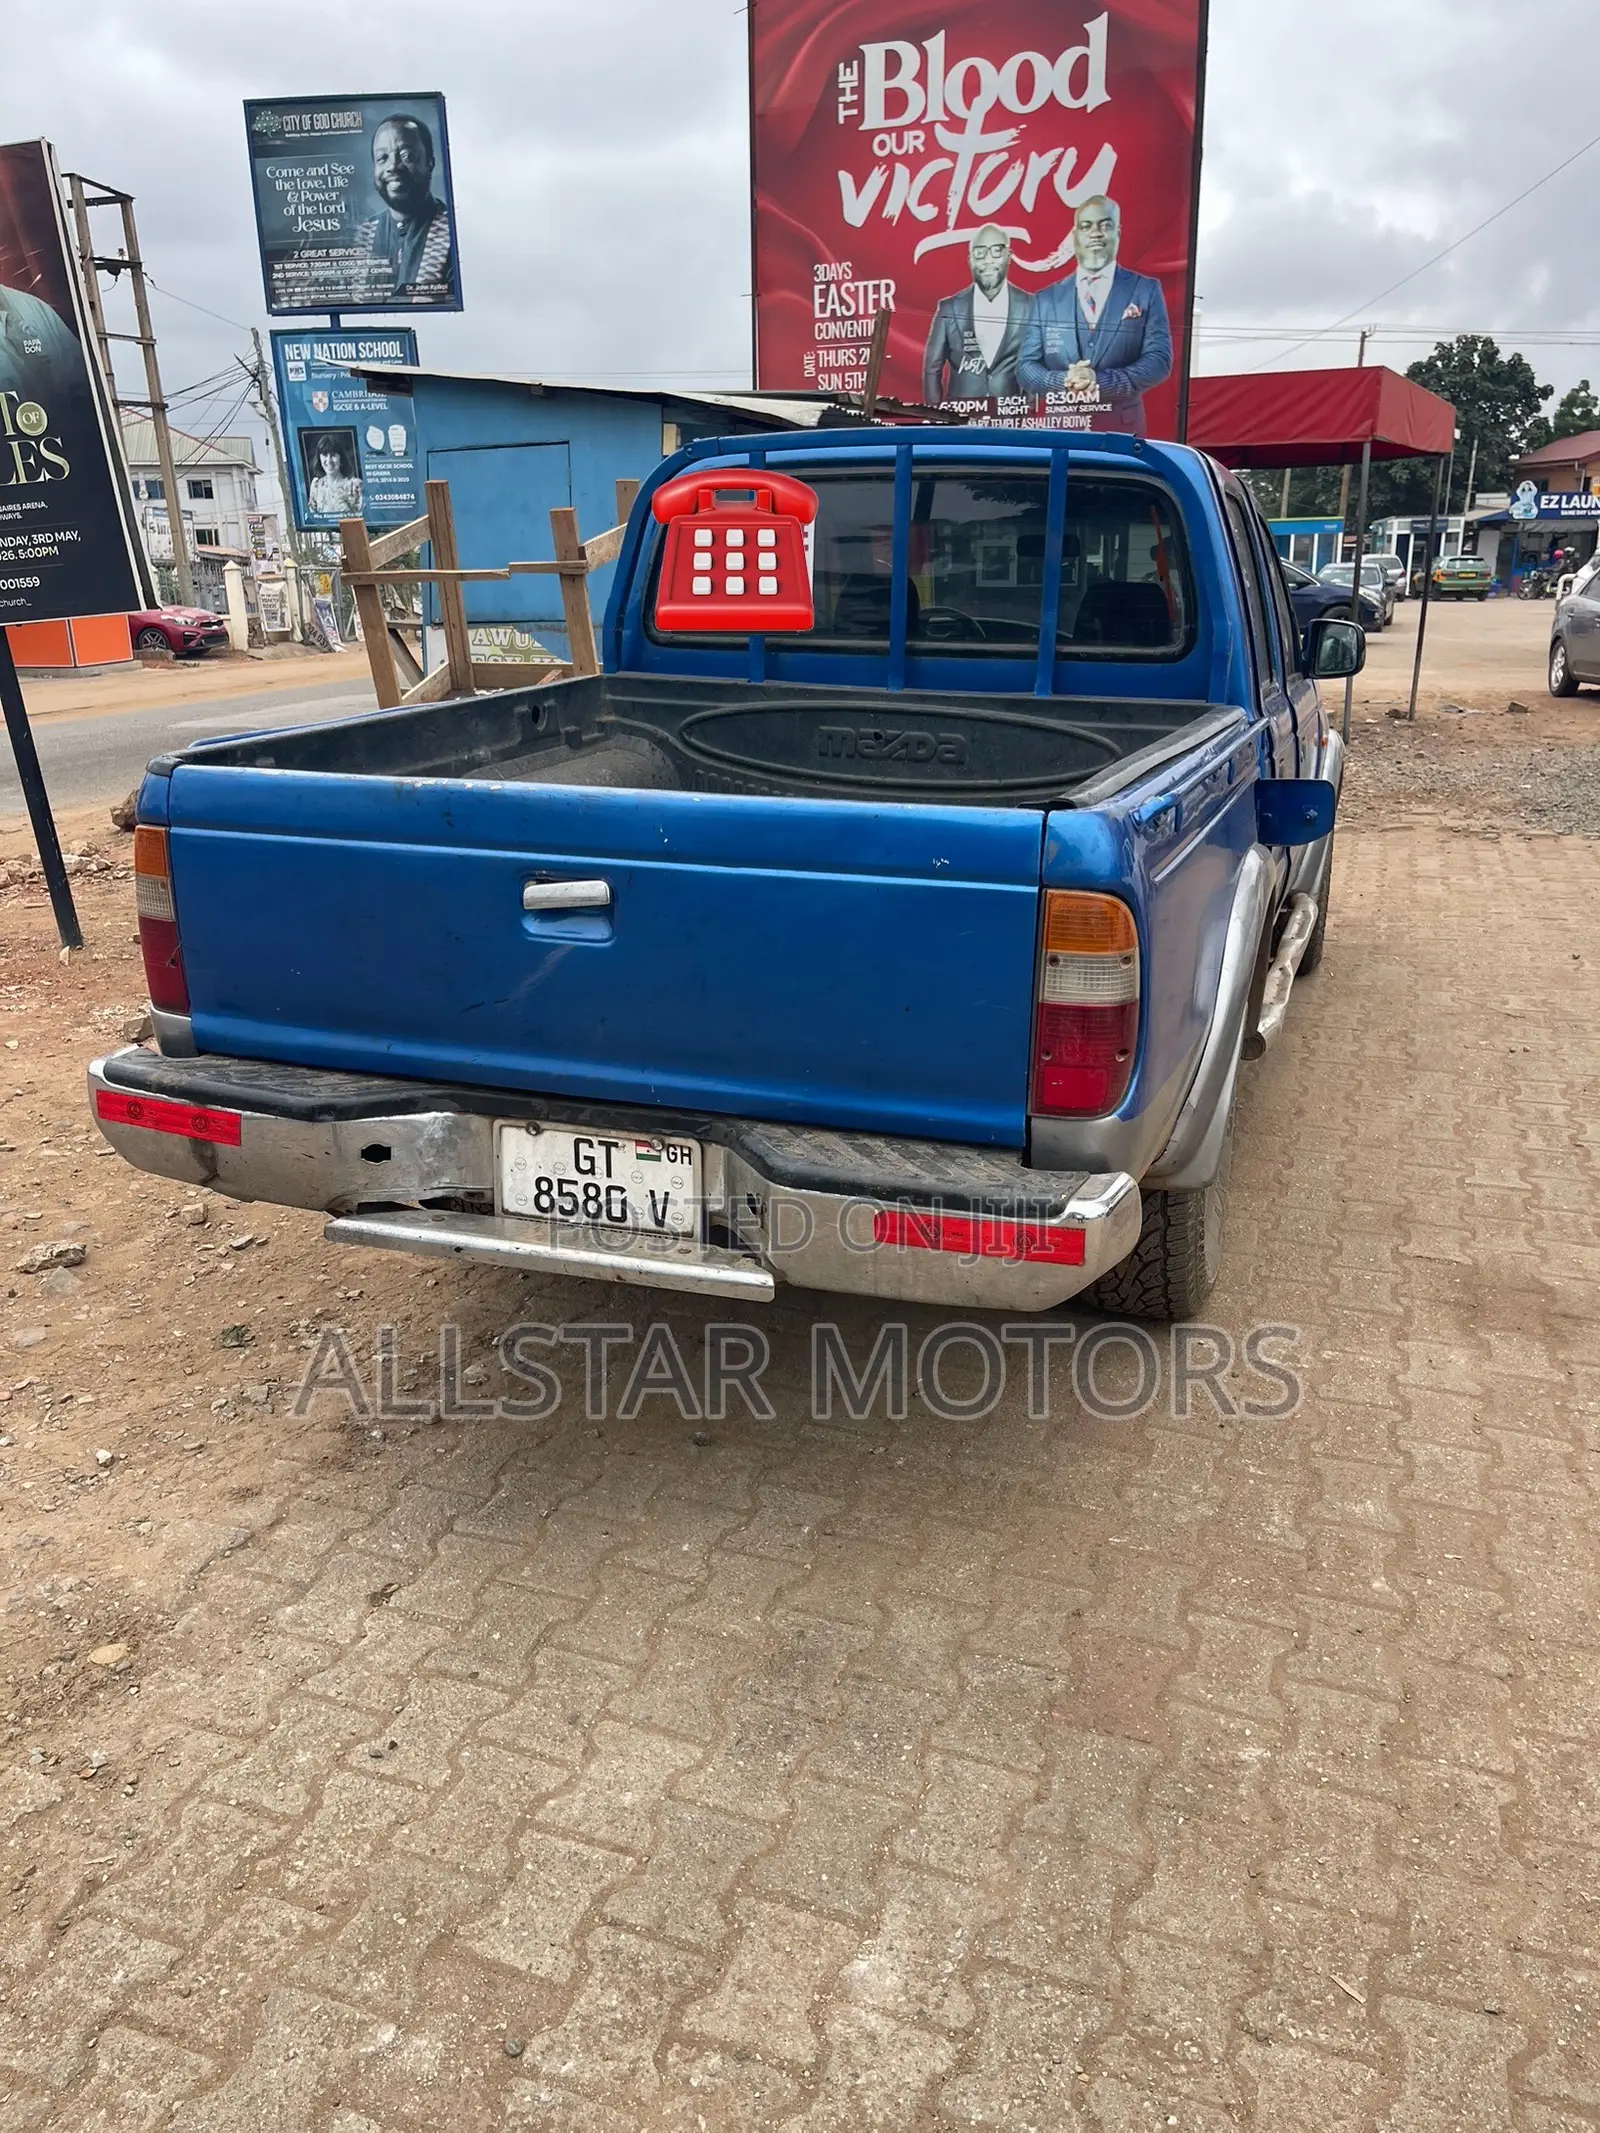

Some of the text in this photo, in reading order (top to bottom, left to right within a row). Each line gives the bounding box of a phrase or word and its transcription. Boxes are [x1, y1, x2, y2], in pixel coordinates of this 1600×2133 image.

[858, 11, 1112, 131] Blood
[837, 60, 859, 124] THE
[282, 111, 363, 131] CITY OF GOD CHURCH
[872, 129, 926, 157] OUR
[266, 162, 355, 179] Come and See
[275, 175, 349, 191] the Love, Life
[287, 190, 340, 203] & Power
[283, 201, 346, 216] of the Lord
[292, 216, 341, 233] Jesus
[293, 246, 368, 259] 2 GREAT SERVICES
[813, 261, 852, 282] 3DAYS
[813, 279, 897, 318] EASTER
[23, 338, 42, 346] PAPA
[25, 345, 42, 354] DON
[284, 341, 404, 360] NEW NATION SCHOOL
[817, 348, 857, 368] THURS
[803, 351, 816, 378] DATE:
[311, 372, 337, 381] Nursery
[817, 372, 842, 391] SUN
[997, 396, 1026, 406] EACH
[1045, 390, 1100, 405] 8:30AM
[333, 403, 353, 411] IGCSE
[360, 402, 388, 410] A-LEVEL
[938, 400, 988, 413] 6:30PM
[997, 405, 1030, 415] NIGHT
[1045, 404, 1113, 413] SUNDAY SERVICE
[22, 411, 40, 425] OF
[1021, 416, 1061, 428] ASHALLEY
[1062, 415, 1092, 428] BOTWE
[22, 501, 49, 510] ARENA,
[1540, 495, 1560, 509] EZ
[55, 530, 81, 543] MAY,
[18, 545, 60, 559] 5:00PM
[573, 1137, 692, 1178] GT GH
[533, 1176, 670, 1228] 8580 V
